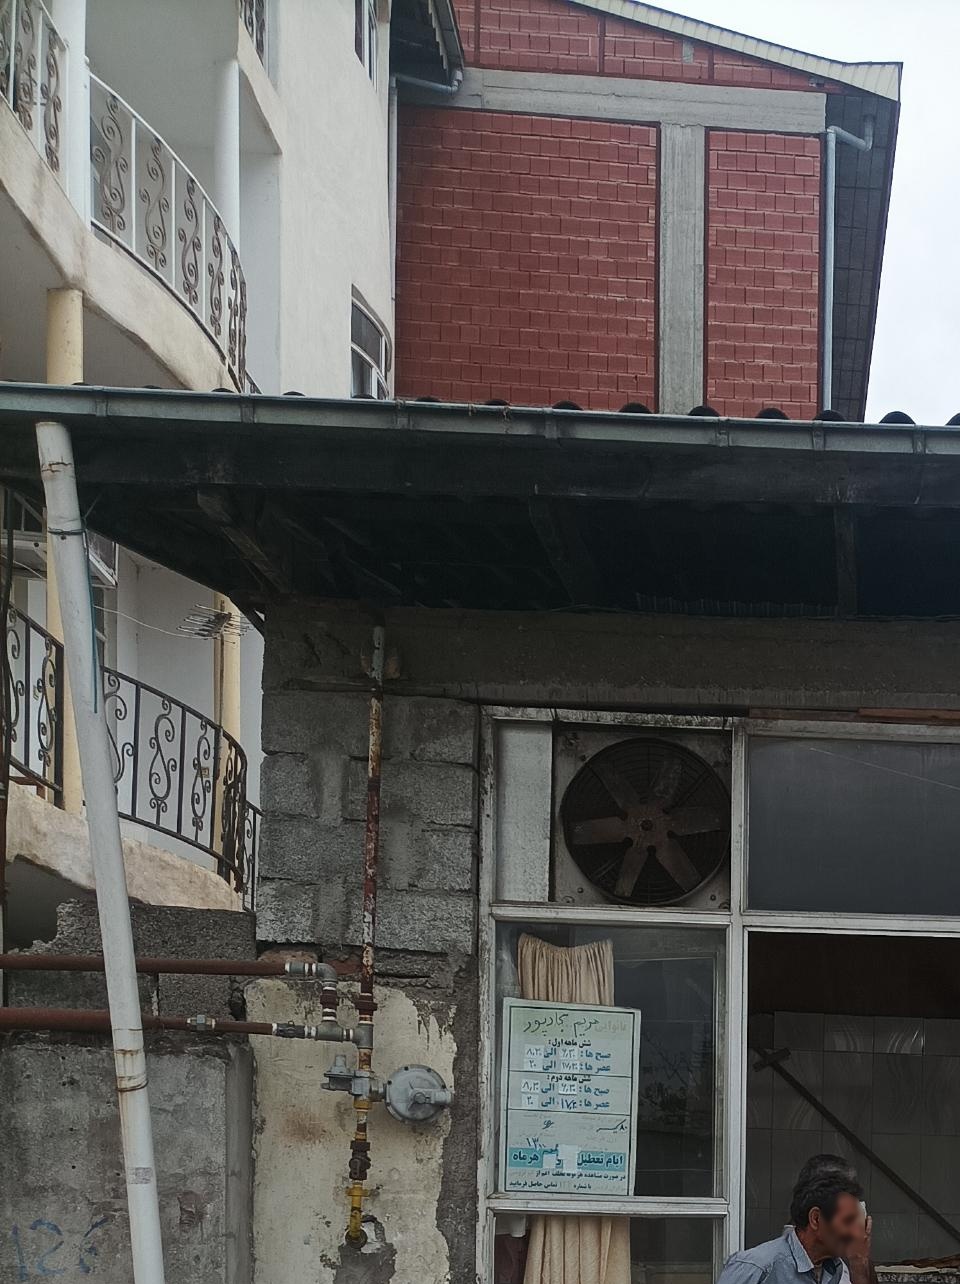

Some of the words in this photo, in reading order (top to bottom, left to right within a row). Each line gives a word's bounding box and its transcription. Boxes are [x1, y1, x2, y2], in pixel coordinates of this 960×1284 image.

[574, 1017, 600, 1038] مریم
[543, 1047, 557, 1059] الی
[595, 1050, 612, 1061] صبح
[542, 1060, 557, 1071] الی
[595, 1064, 611, 1074] عصر
[540, 1082, 555, 1094] الی
[593, 1087, 610, 1097] صبح
[540, 1096, 555, 1107] الی
[593, 1101, 610, 1110] عصر
[512, 1150, 527, 1161] ماه
[527, 1153, 539, 1164] هر
[576, 1151, 604, 1167] تعطیل
[605, 1155, 623, 1168] ایام
